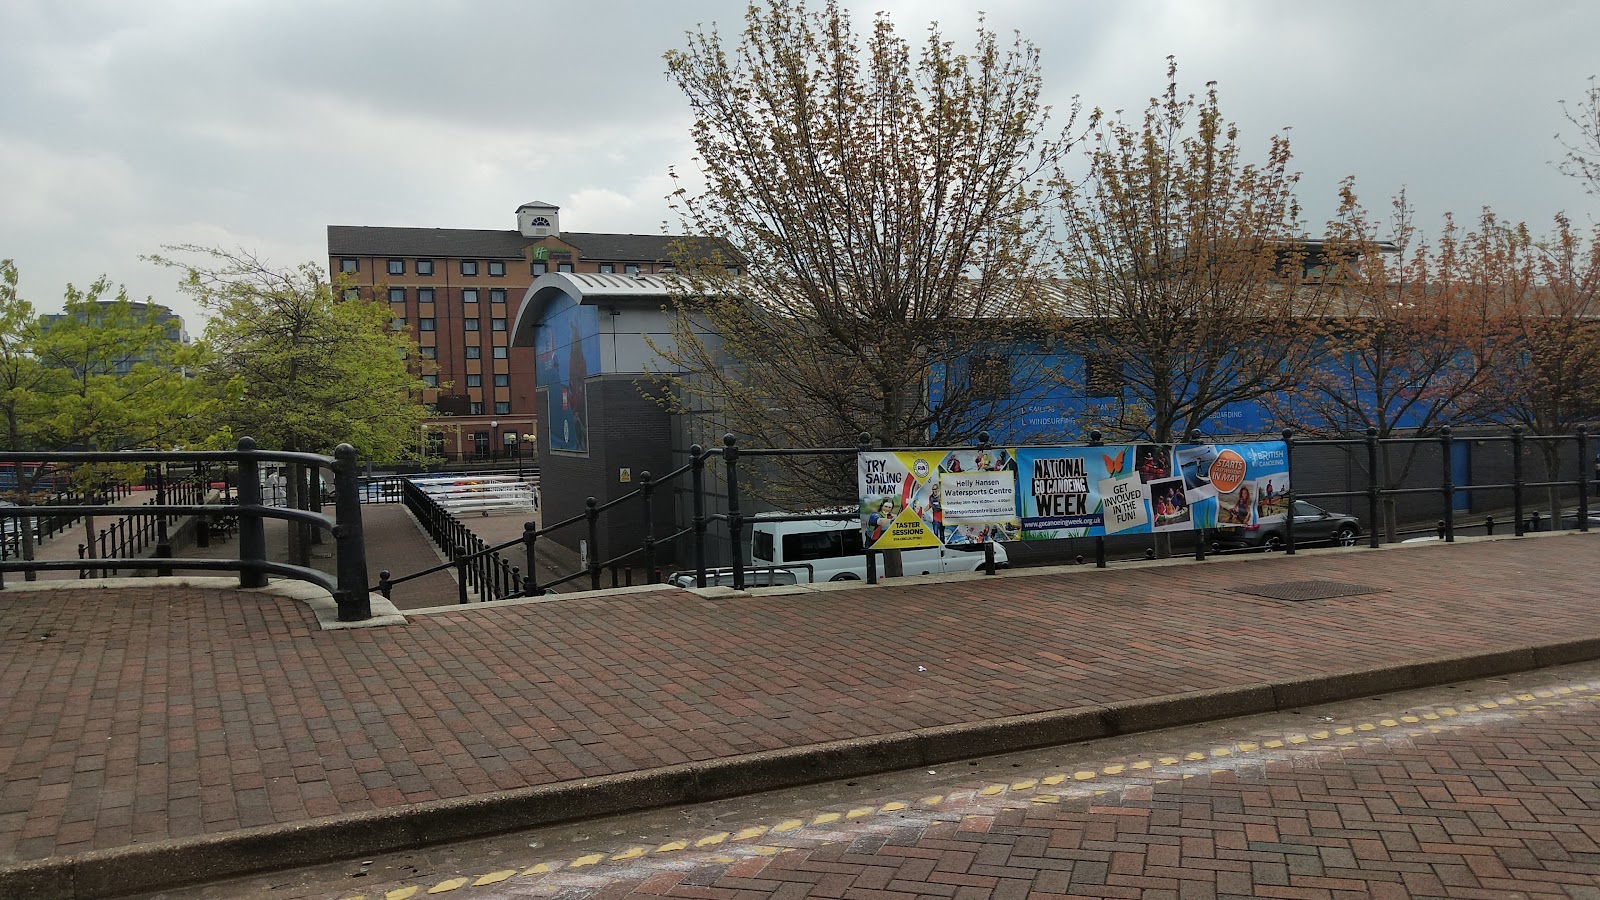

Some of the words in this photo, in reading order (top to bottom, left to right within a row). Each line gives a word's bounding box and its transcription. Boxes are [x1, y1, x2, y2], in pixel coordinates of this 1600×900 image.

[1258, 450, 1284, 462] BRITISH
[865, 459, 887, 473] TRY
[1034, 457, 1088, 479] NATIONAL
[1216, 459, 1243, 470] STARTS
[1259, 459, 1284, 468] CANOEING
[1211, 471, 1222, 480] IN
[1221, 473, 1240, 482] MAY
[878, 485, 897, 494] MAY
[956, 479, 974, 488] Helly
[1034, 479, 1046, 494] GO
[1047, 478, 1086, 494] CANOEING
[1113, 482, 1128, 495] GET
[944, 488, 988, 497] Watersports
[988, 487, 1012, 495] Centre
[1103, 489, 1142, 507] INVOLVED
[1035, 494, 1088, 517] WEEK
[1113, 504, 1122, 515] IN
[1121, 500, 1137, 512] THE
[1023, 517, 1102, 529] www.gocanoeingweek.org.uk
[1117, 510, 1136, 524] FUN!
[895, 521, 921, 529] TASTER
[892, 528, 924, 536] SESSIONS
